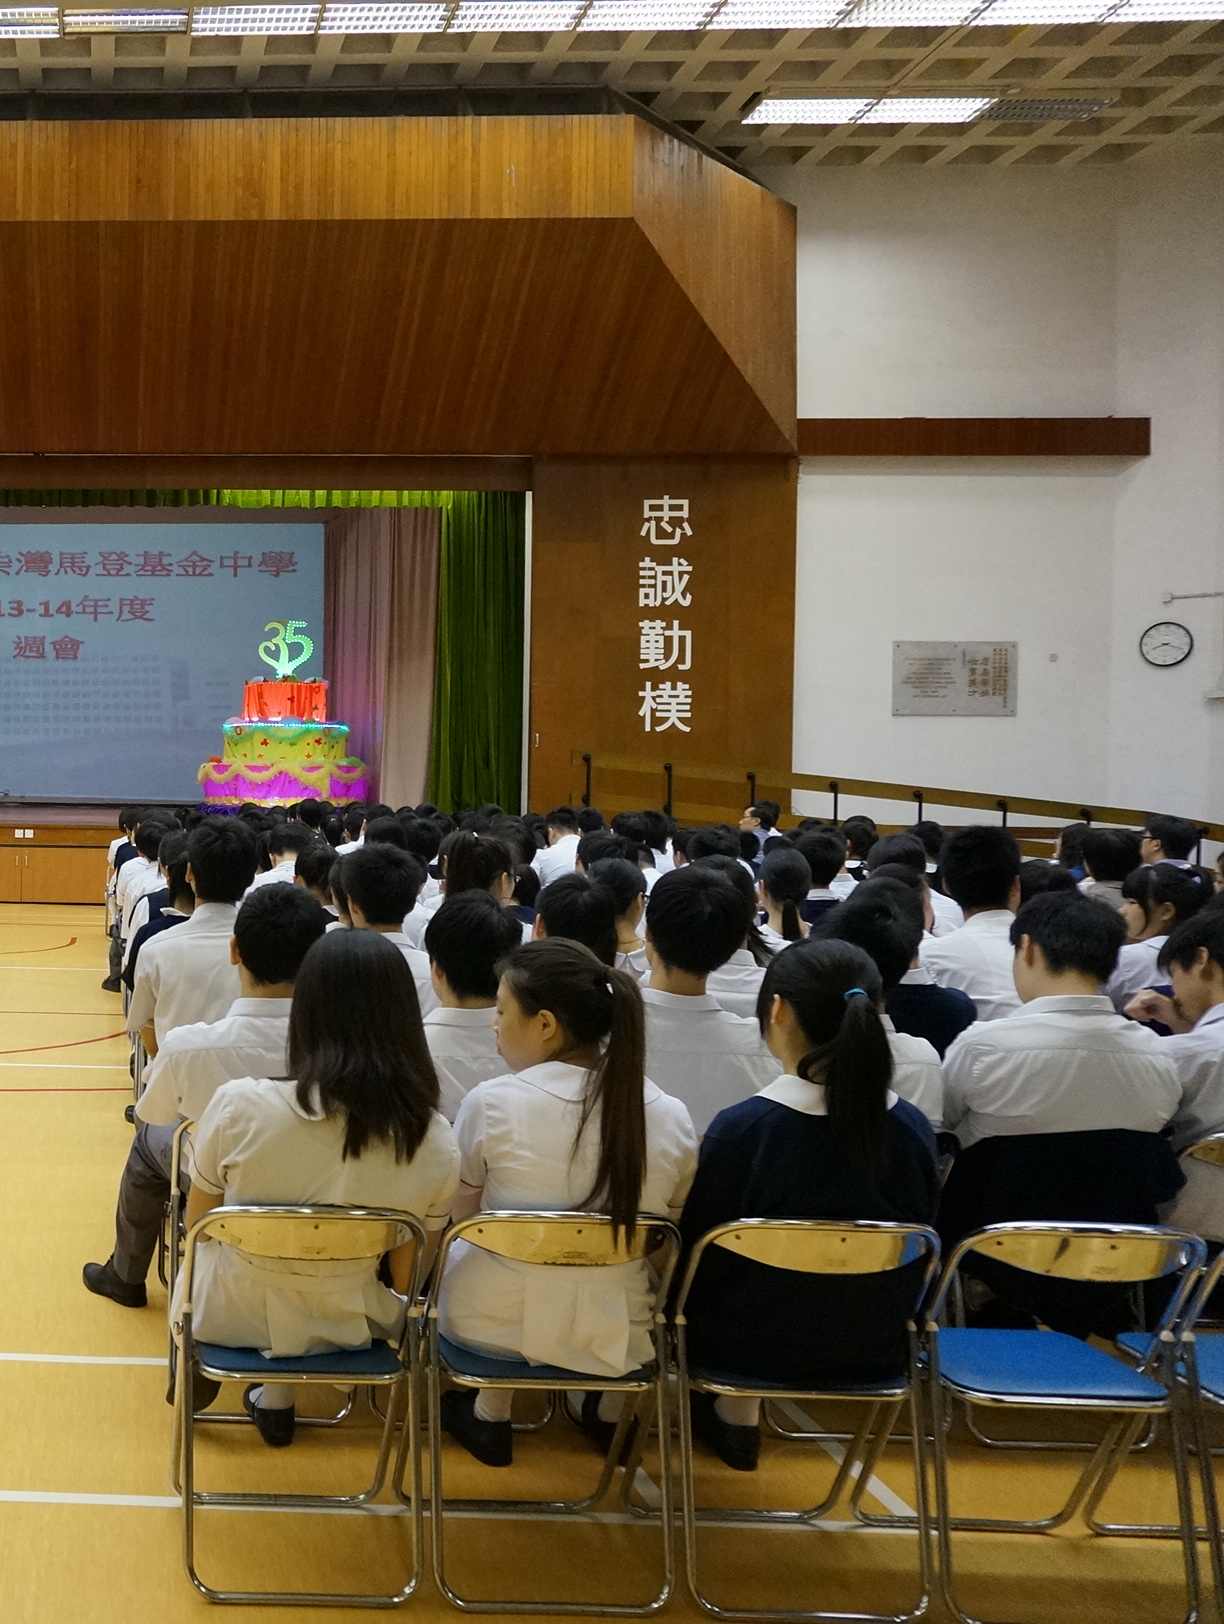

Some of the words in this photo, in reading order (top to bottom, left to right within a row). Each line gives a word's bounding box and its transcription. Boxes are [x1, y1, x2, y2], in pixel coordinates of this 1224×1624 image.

[638, 495, 693, 732] 忠誠勤樸
[12, 634, 85, 660] 週會
[258, 620, 314, 676] 35
